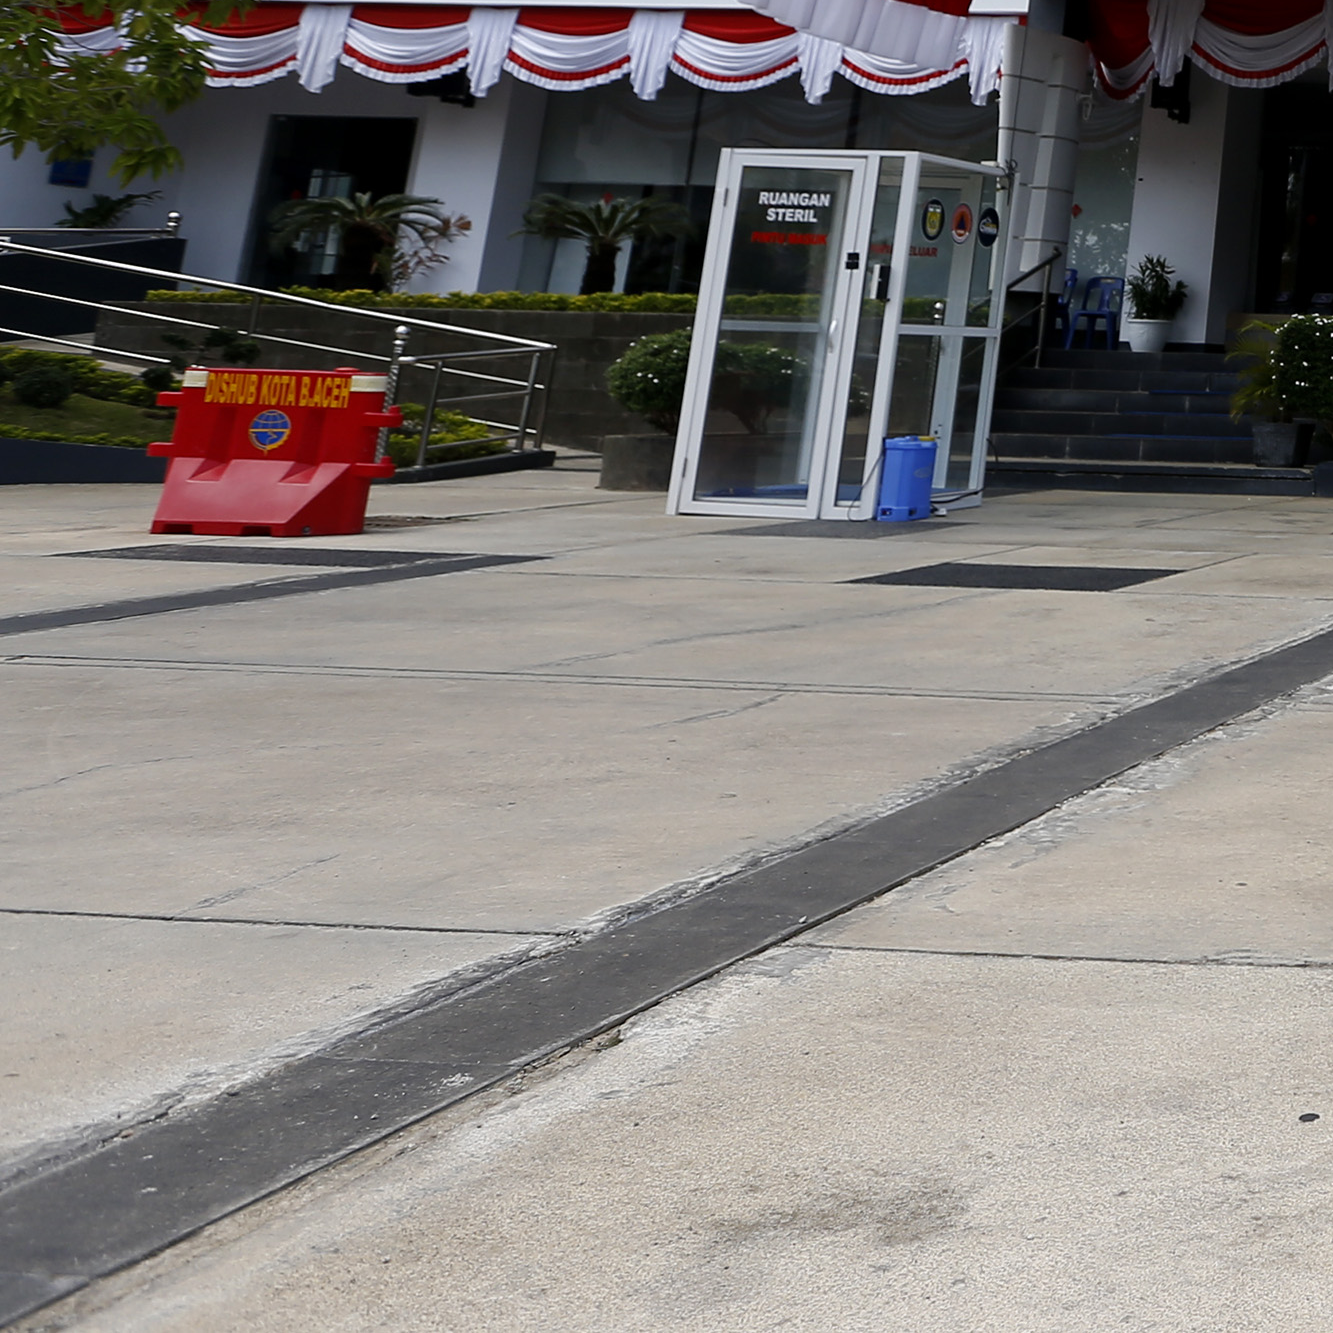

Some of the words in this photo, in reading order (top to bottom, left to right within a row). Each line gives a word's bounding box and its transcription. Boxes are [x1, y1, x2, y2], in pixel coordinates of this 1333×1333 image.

[758, 191, 831, 207] RUANGAN
[766, 207, 818, 223] STERIL
[204, 372, 259, 404] DISHUB
[259, 375, 297, 406] KOTA
[299, 376, 351, 409] B.ACEH
